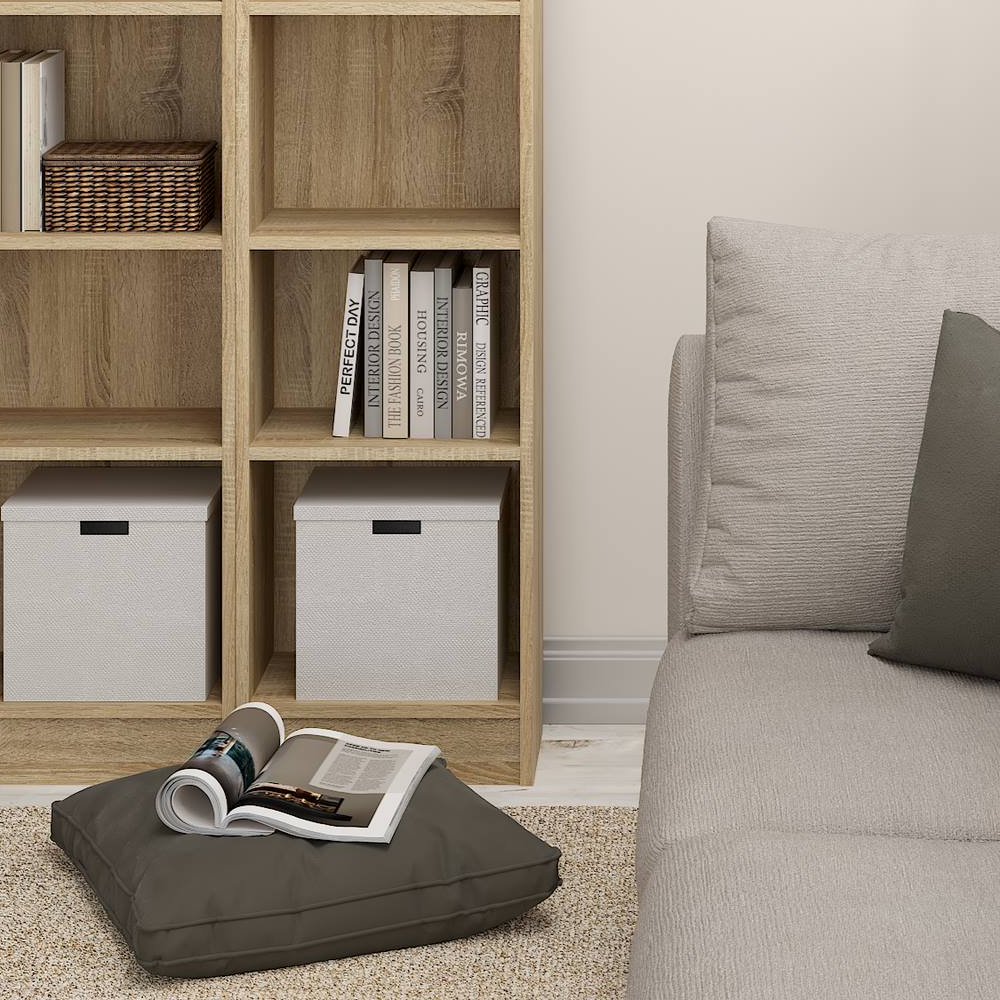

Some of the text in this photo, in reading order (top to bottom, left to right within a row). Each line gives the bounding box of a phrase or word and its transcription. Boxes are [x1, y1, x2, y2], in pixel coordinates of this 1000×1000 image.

[340, 299, 360, 395] PERFECT DAY
[475, 272, 489, 326] GRAPHIC
[368, 290, 380, 408] INTERIOR DESIGN
[388, 325, 402, 428] THE FASHION BOOK
[416, 310, 427, 417] HOUSING CAIRO
[437, 297, 449, 410] INTERIOR DESIGN
[456, 332, 468, 401] RIMOWA
[475, 379, 486, 438] REFERENCED
